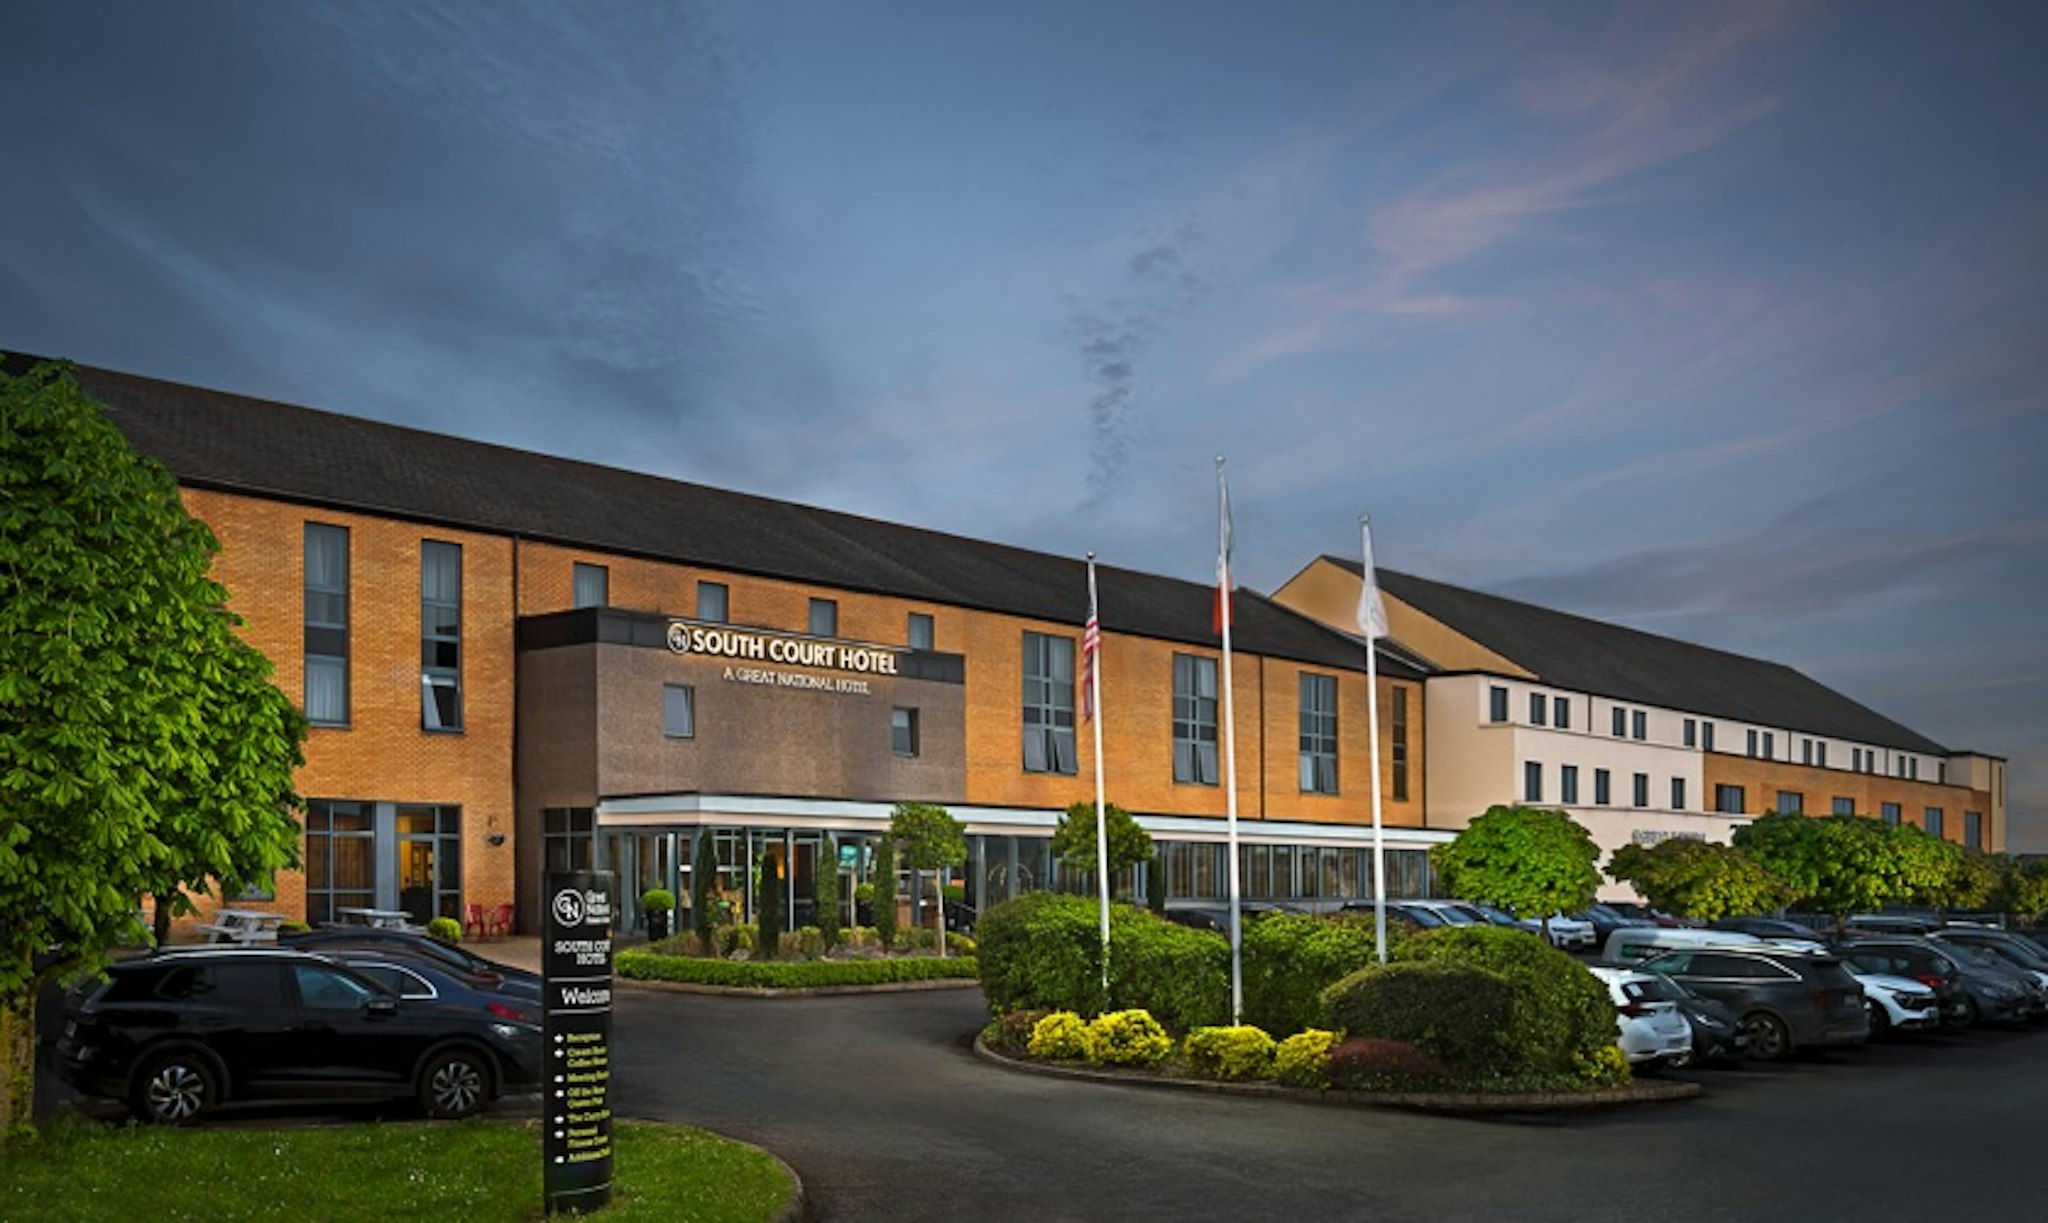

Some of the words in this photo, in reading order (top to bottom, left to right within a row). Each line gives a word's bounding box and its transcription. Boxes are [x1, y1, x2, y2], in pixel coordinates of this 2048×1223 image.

[692, 629, 765, 659] SOUTH
[769, 639, 836, 667] COURT
[840, 650, 898, 674] HOTEL
[723, 667, 735, 681] A
[736, 669, 777, 684] GREAT
[777, 672, 834, 691] NATIONAL
[835, 678, 871, 695] HOTEL
[554, 940, 593, 954] SOUTH
